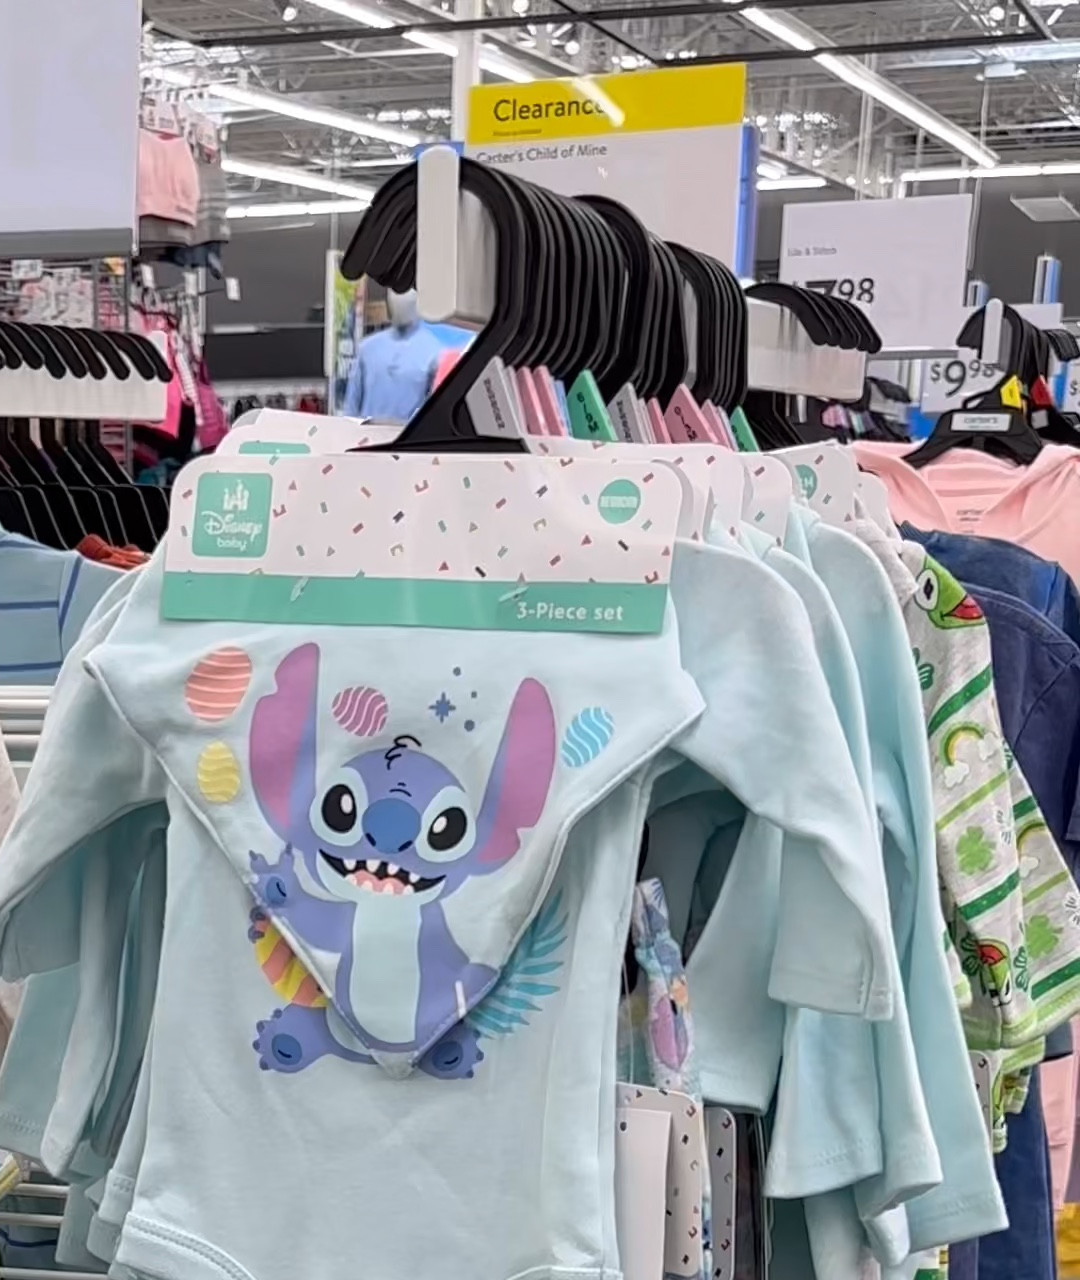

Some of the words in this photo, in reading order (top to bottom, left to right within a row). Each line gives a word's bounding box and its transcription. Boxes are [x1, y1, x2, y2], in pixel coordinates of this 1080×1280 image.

[526, 147, 558, 161] Child
[560, 144, 575, 158] of
[576, 144, 607, 157] Mine
[201, 510, 263, 542] Disney
[216, 537, 248, 551] baby
[516, 603, 588, 620] 3-Piece
[593, 605, 624, 621] set
